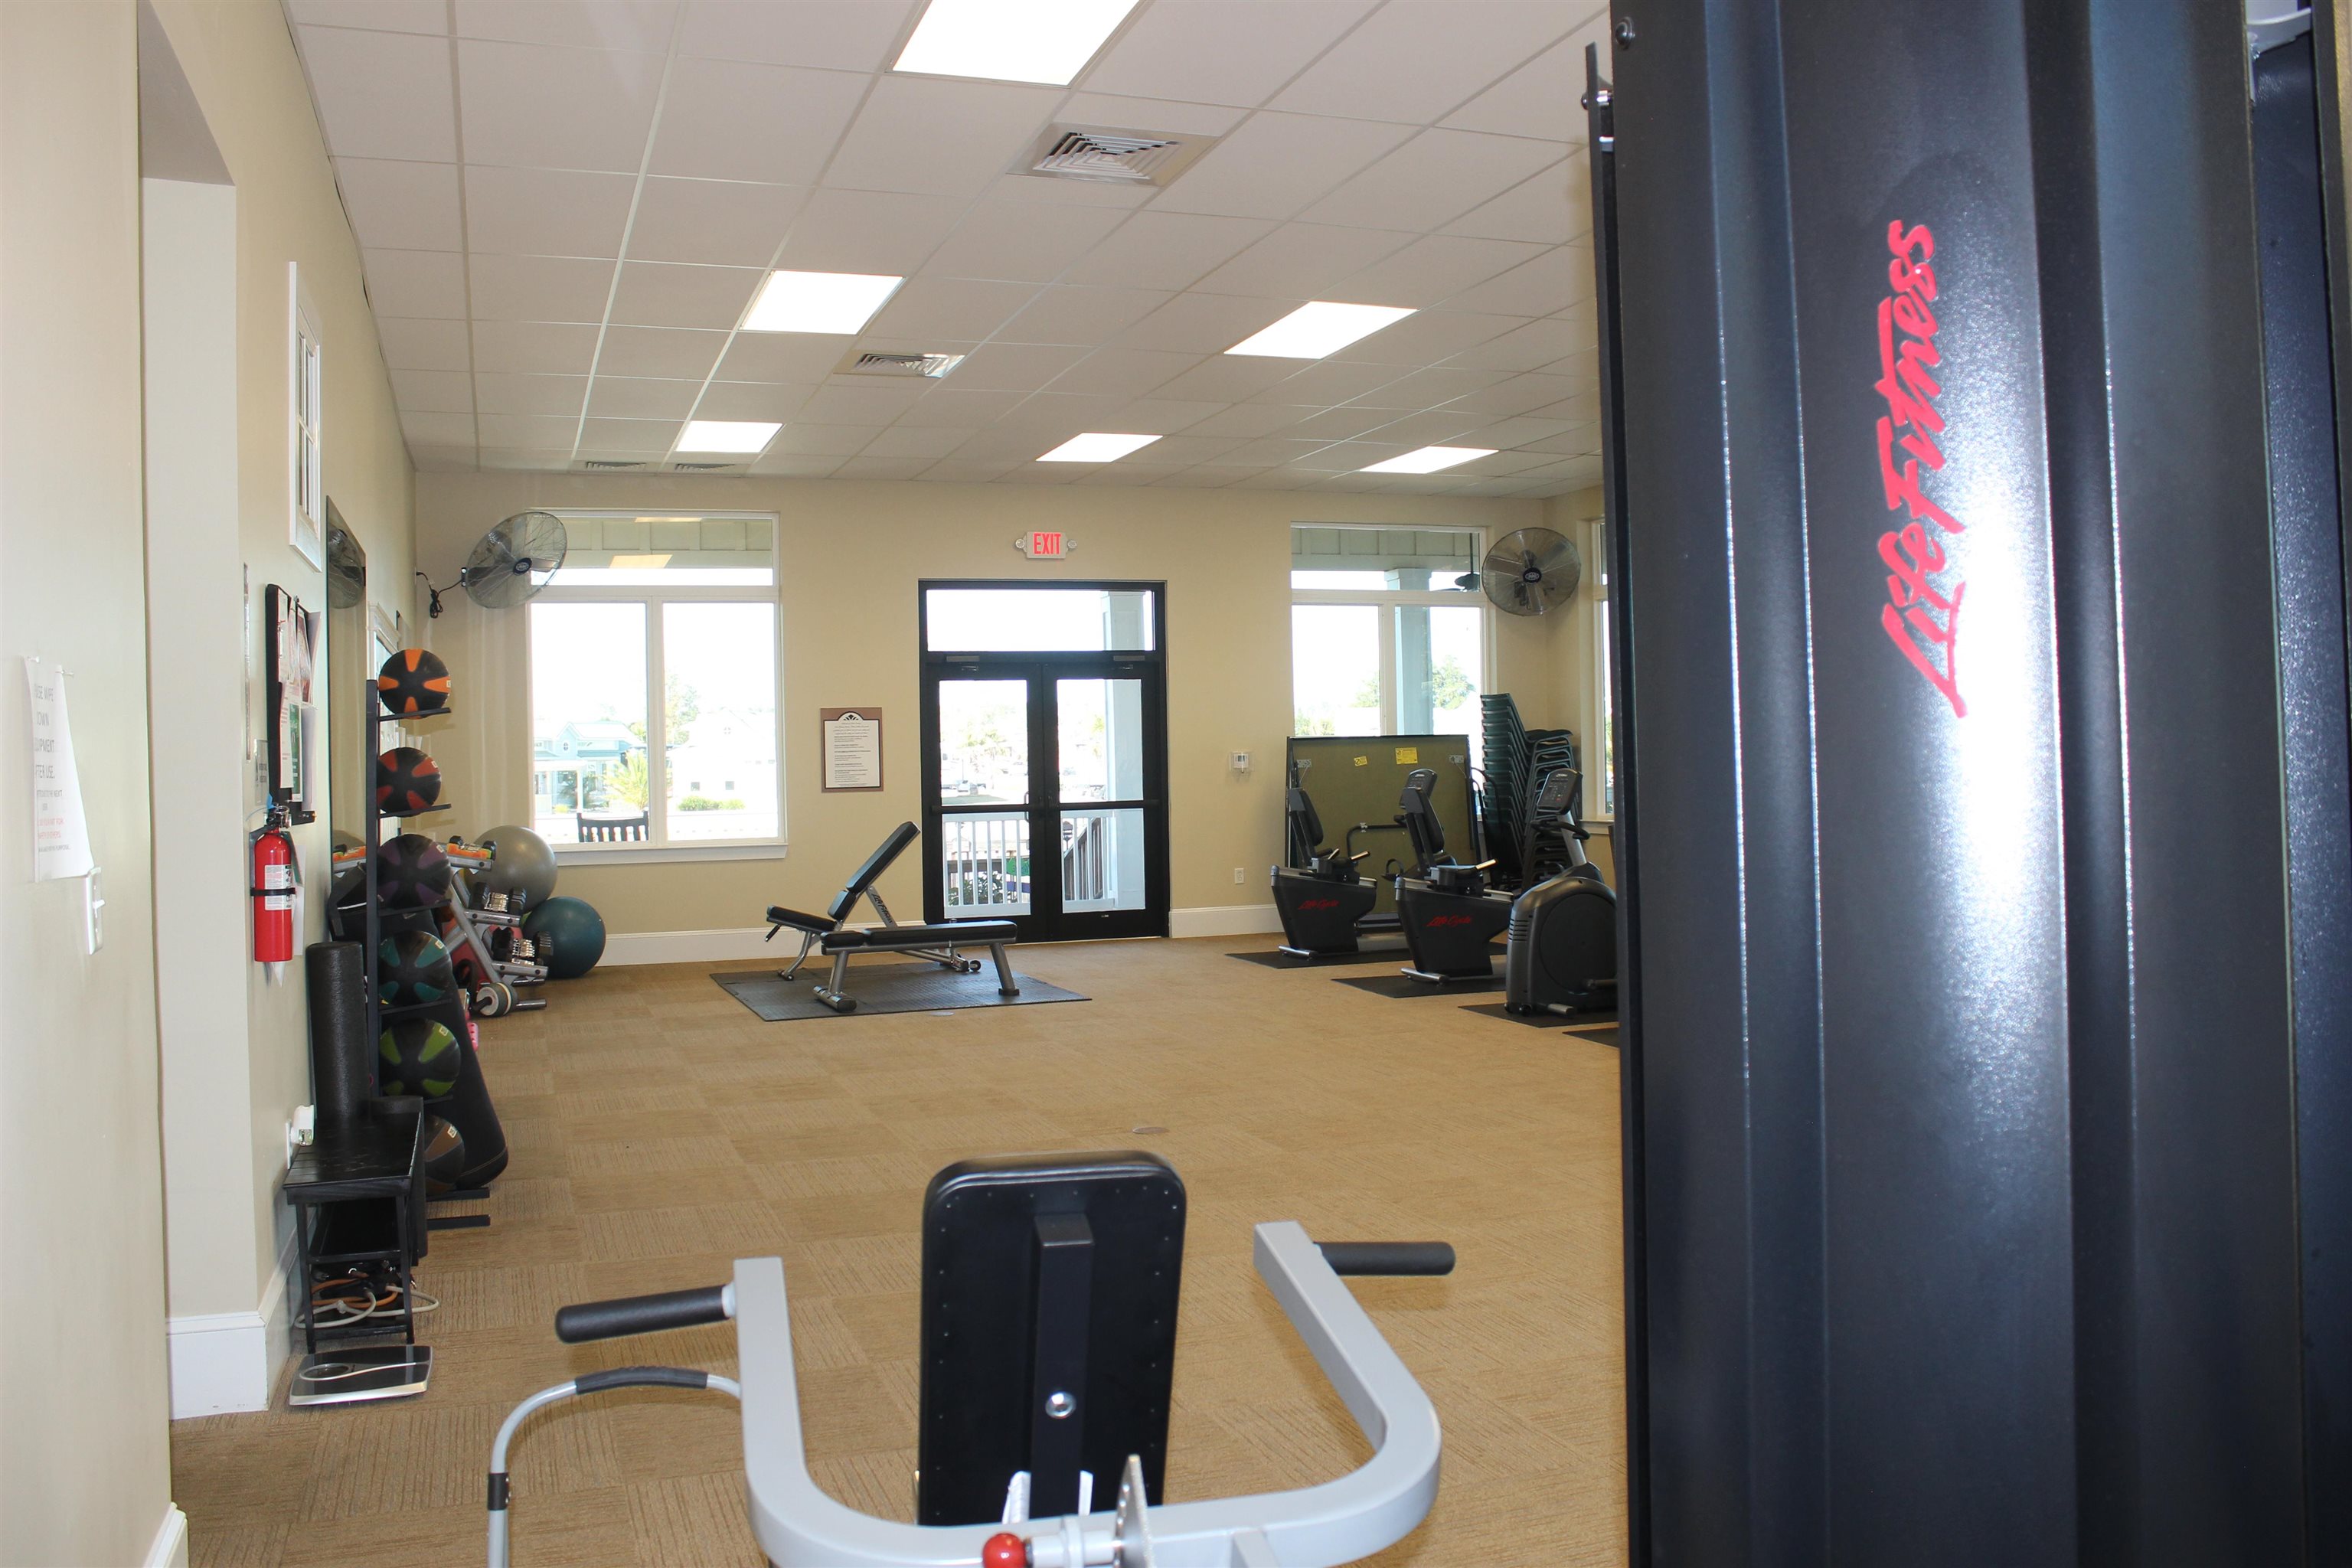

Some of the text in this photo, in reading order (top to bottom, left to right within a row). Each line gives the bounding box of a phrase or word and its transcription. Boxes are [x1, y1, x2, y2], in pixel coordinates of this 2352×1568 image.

[1034, 532, 1061, 554] EXIT
[1875, 220, 1967, 718] Life Fitness
